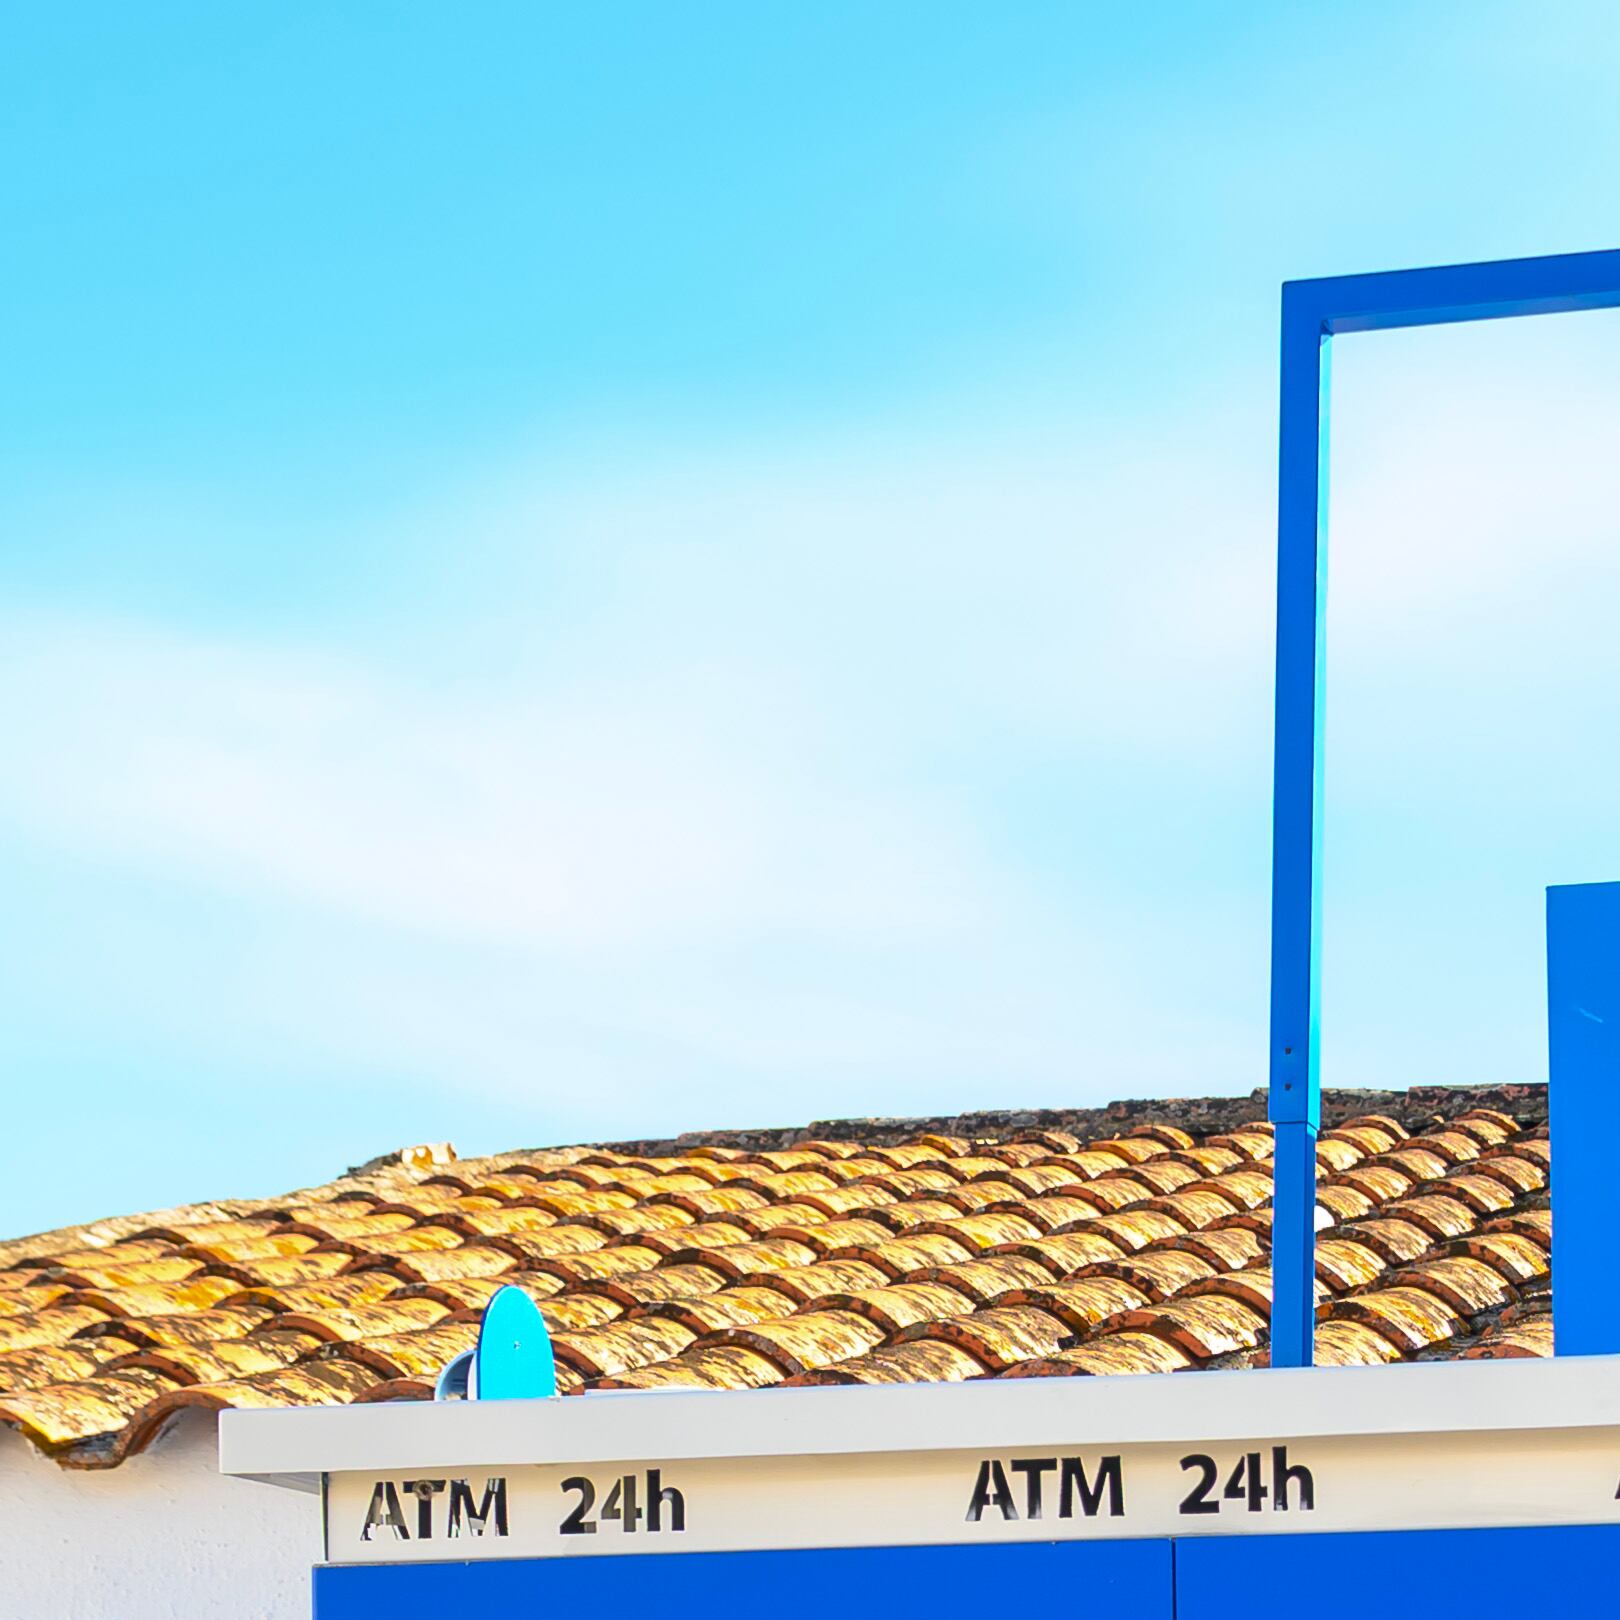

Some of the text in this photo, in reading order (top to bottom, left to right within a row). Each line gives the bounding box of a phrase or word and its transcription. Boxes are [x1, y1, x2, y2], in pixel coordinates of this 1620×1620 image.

[361, 1468, 685, 1541] ATM 24h
[967, 1445, 1314, 1522] ATM 24h
